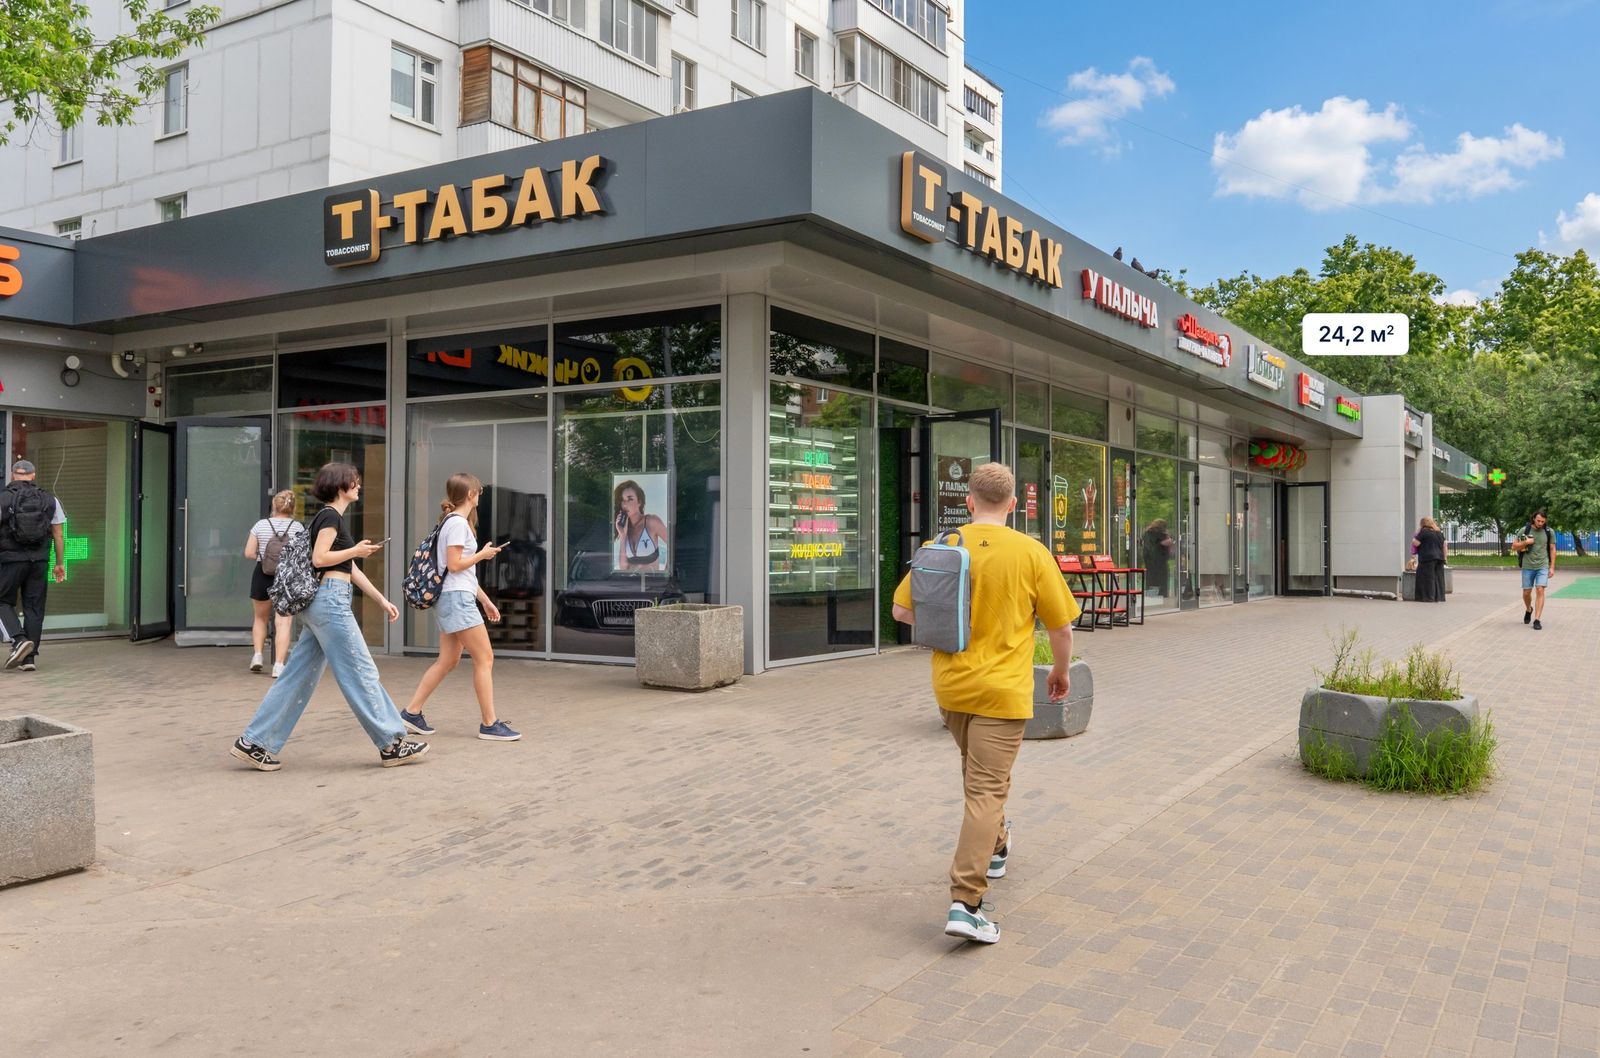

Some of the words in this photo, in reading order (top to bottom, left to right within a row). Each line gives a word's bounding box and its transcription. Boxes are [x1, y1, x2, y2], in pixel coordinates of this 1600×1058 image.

[913, 211, 945, 233] TOBACCONIST
[325, 243, 370, 257] TOBACCONIST
[1087, 270, 1099, 299] У
[1102, 276, 1159, 328] ПАЛЫЧА
[801, 473, 832, 490] ТАБАК
[946, 482, 969, 491] ПАЛЫЧ
[790, 543, 843, 560] ЖИДКОСТИ
